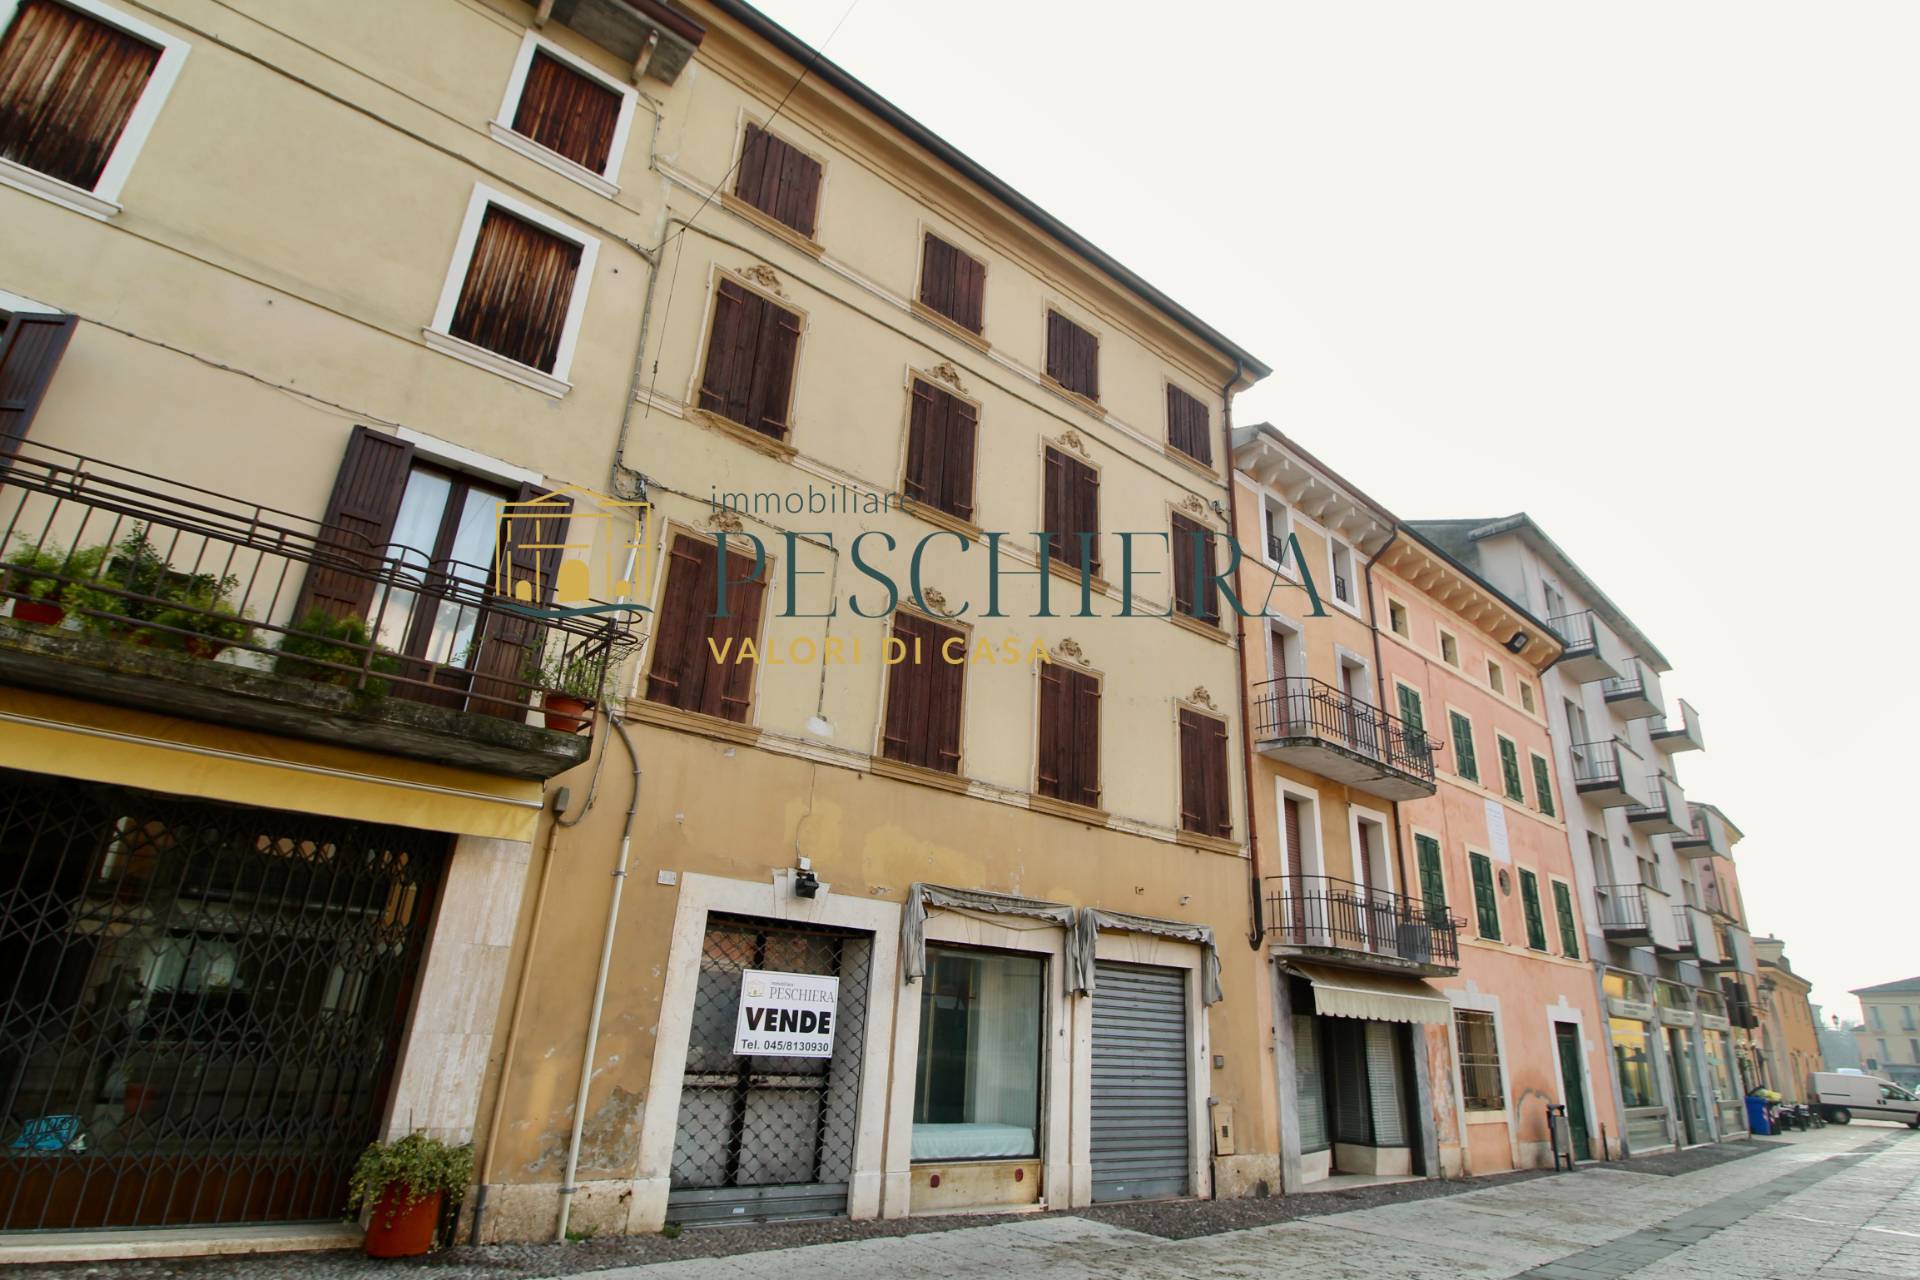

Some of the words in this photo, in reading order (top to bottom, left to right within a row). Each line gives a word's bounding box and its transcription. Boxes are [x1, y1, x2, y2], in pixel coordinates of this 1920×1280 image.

[768, 986, 835, 1003] PESCHIERA
[745, 1007, 832, 1034] VENDE
[741, 1039, 760, 1050] Tel.
[763, 1040, 829, 1052] 045/8130930
